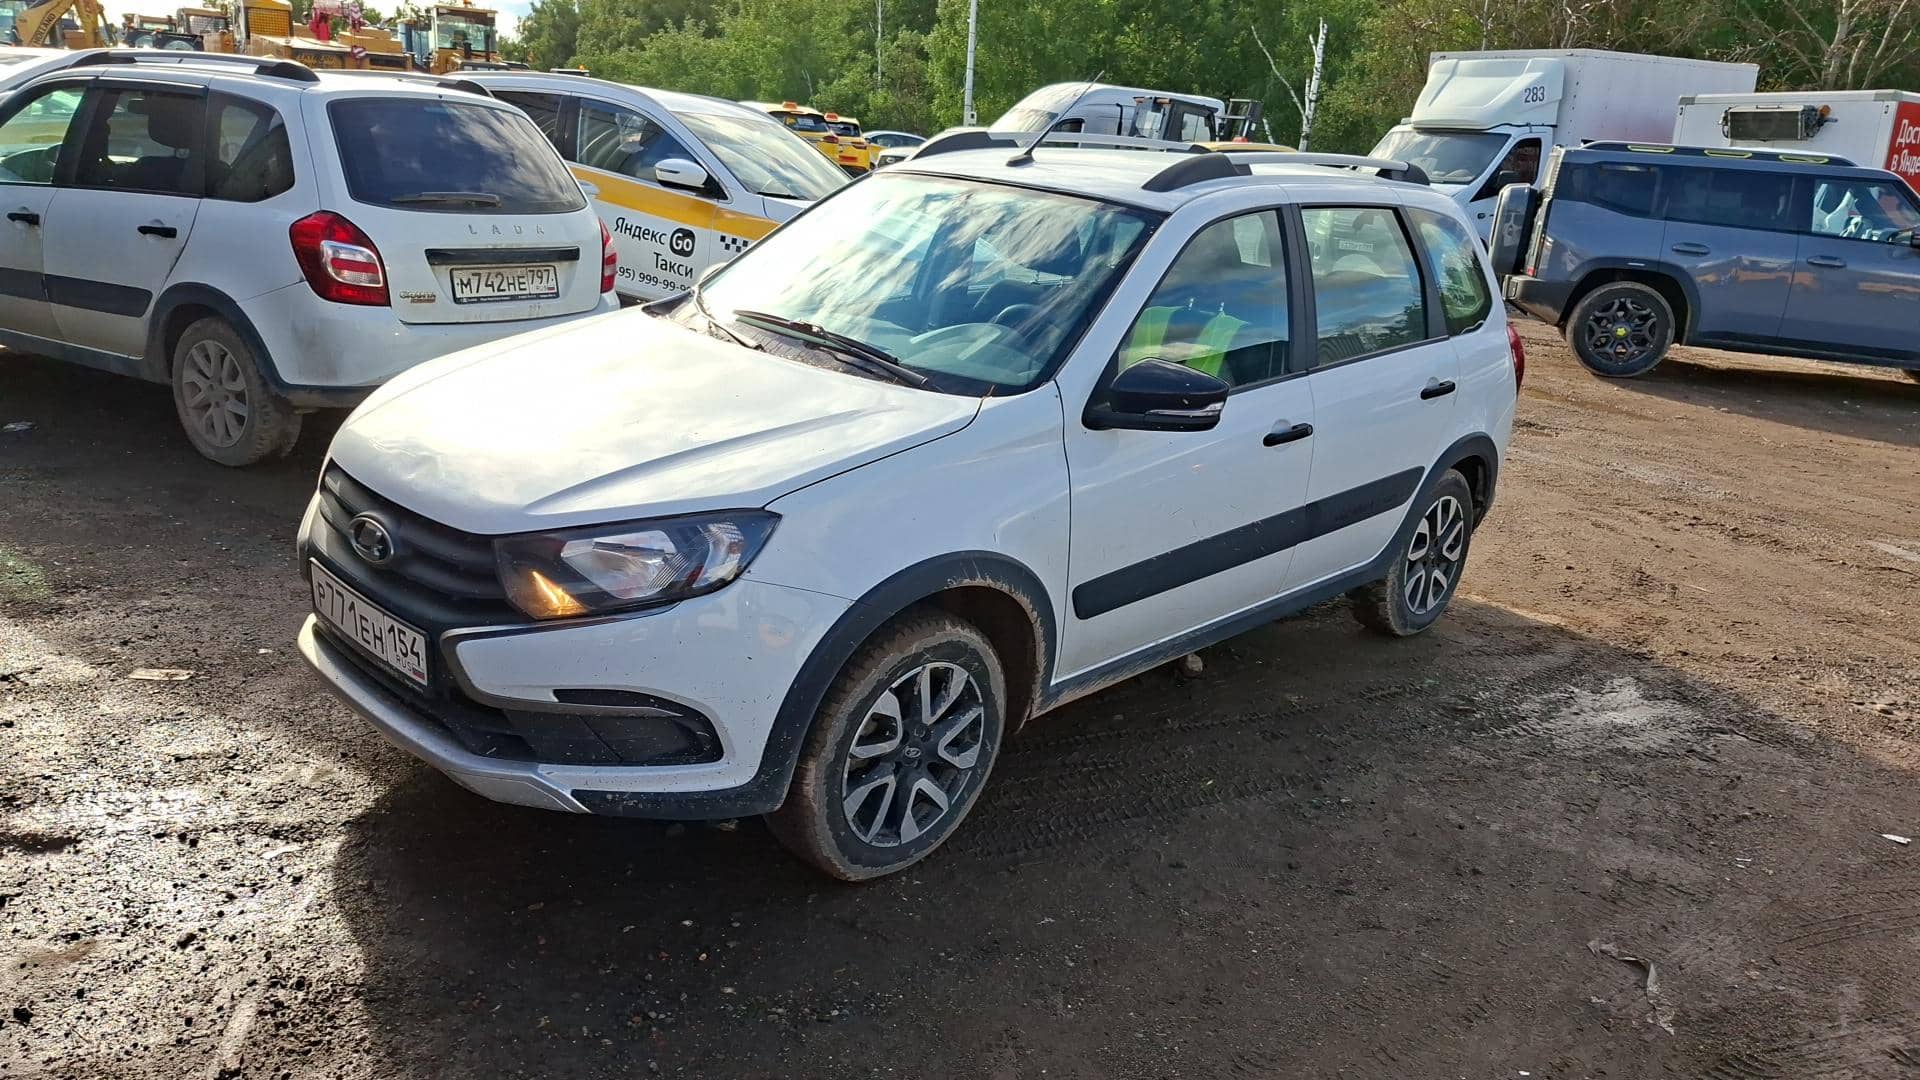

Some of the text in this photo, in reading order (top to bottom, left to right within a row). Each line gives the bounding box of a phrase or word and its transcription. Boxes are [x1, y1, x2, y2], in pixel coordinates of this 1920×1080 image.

[1524, 86, 1545, 103] 283
[1890, 154, 1899, 171] в
[468, 224, 545, 235] LADA
[614, 216, 667, 246] Яндекс
[671, 231, 693, 252] Go
[653, 252, 694, 280] Такси
[528, 269, 550, 285] 797
[387, 624, 421, 667] 154
